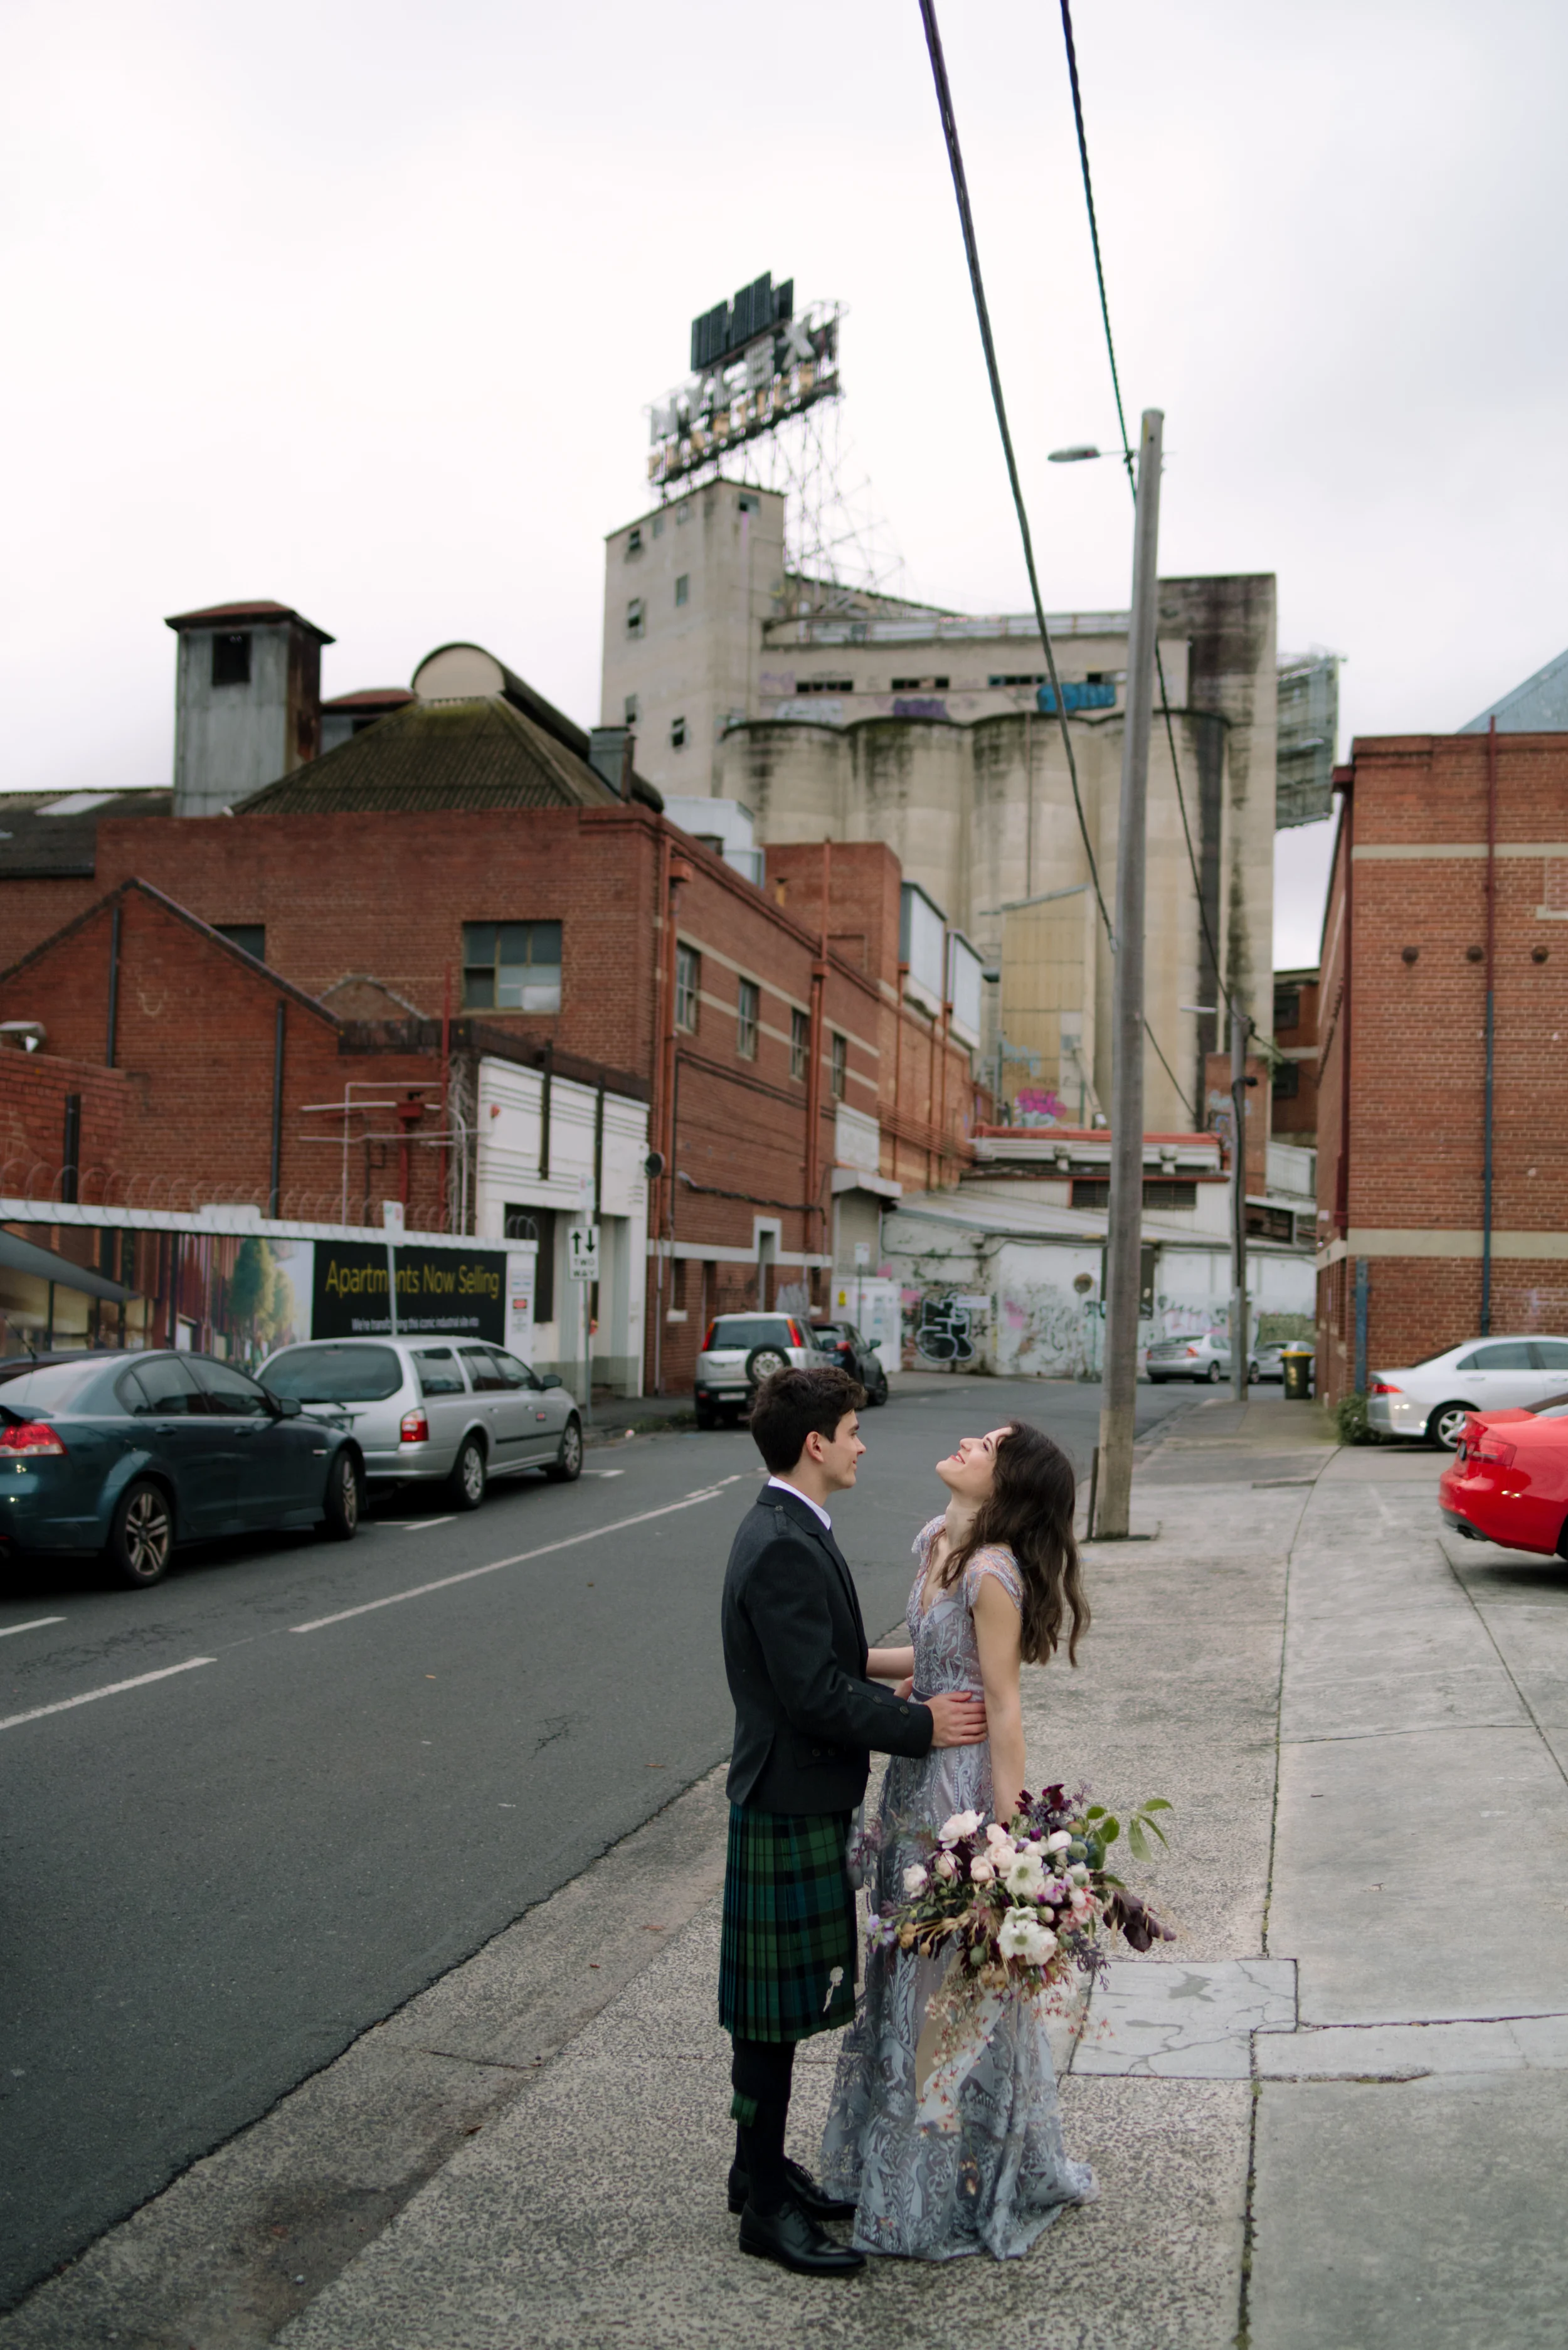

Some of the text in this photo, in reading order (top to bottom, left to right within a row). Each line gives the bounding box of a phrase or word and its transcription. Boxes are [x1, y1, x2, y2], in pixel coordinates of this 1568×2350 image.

[574, 1258, 595, 1266] TWO
[325, 1259, 499, 1300] Apartmnts Now Selling
